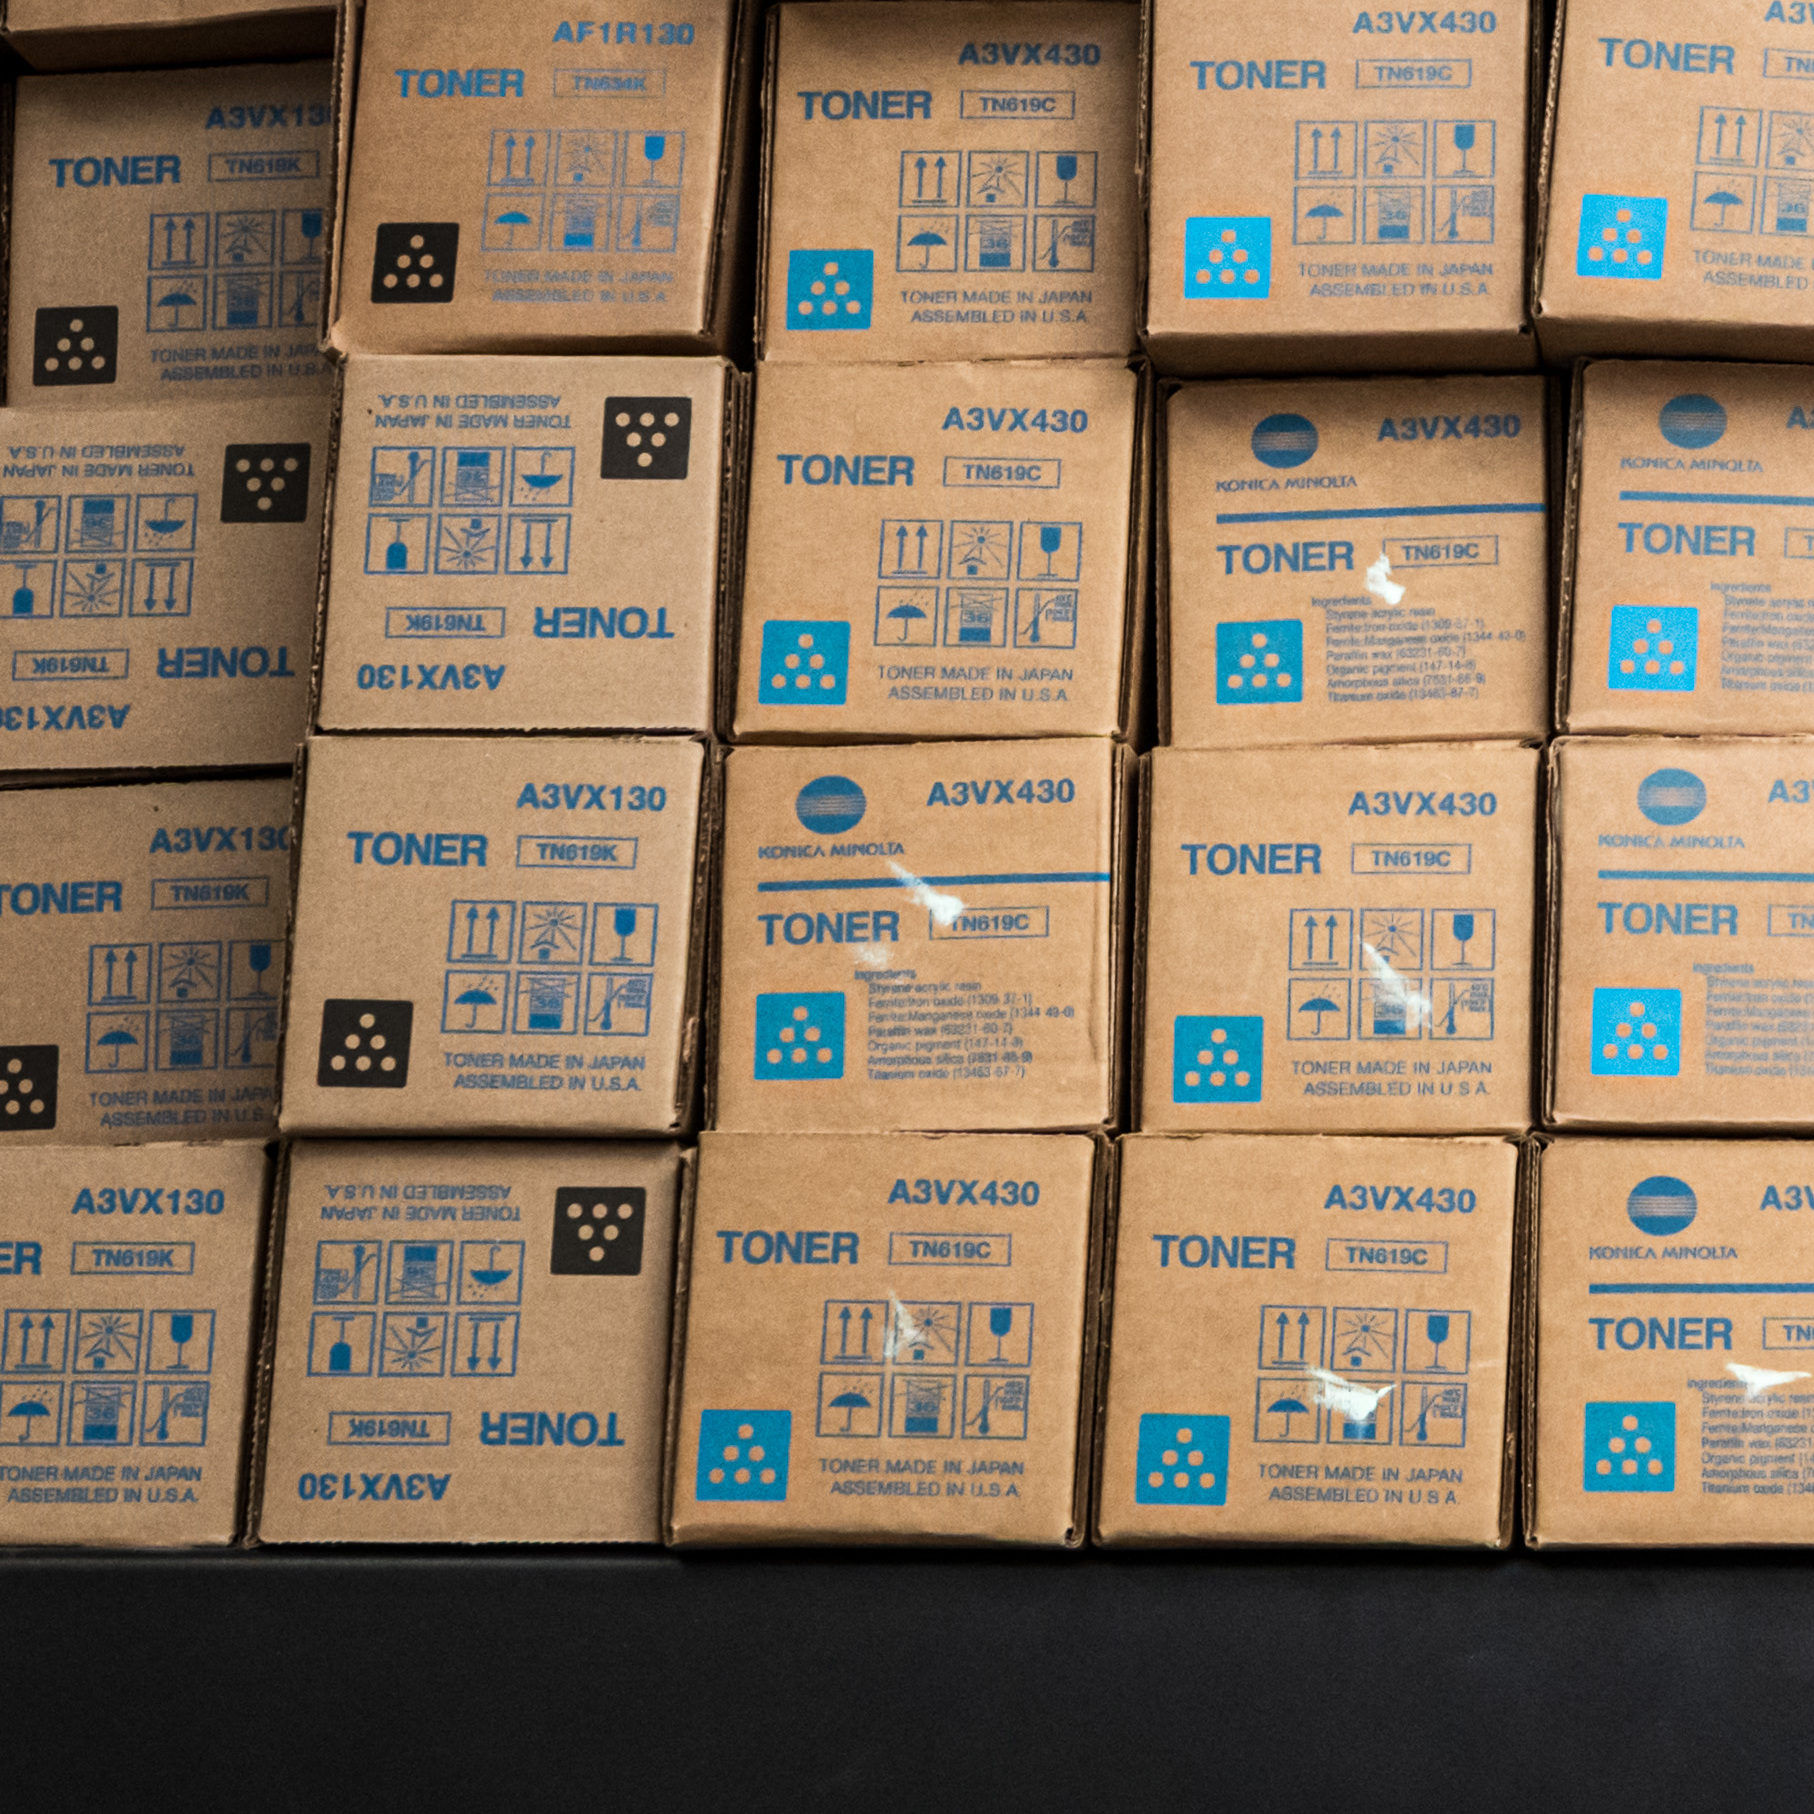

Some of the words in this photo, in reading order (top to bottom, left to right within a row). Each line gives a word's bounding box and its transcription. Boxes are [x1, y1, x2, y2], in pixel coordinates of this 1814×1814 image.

[959, 43, 1102, 67] A3VX430
[1599, 39, 1735, 75] TONER
[798, 91, 933, 121] TONER
[978, 95, 1057, 114] TN619C
[518, 784, 668, 813] A3VX130
[348, 832, 489, 868] TONER
[536, 841, 619, 863] TN619K
[444, 1053, 503, 1068] TONER
[509, 1053, 560, 1069] MADE
[565, 1055, 583, 1070] IN
[569, 1076, 585, 1090] IN
[1325, 1186, 1477, 1215] A3VX430
[1154, 1235, 1297, 1270] TONER
[1345, 1245, 1429, 1267] TN619C
[349, 1418, 430, 1438] TN619K
[479, 1411, 625, 1447] TONER
[298, 1472, 452, 1500] A3VX130
